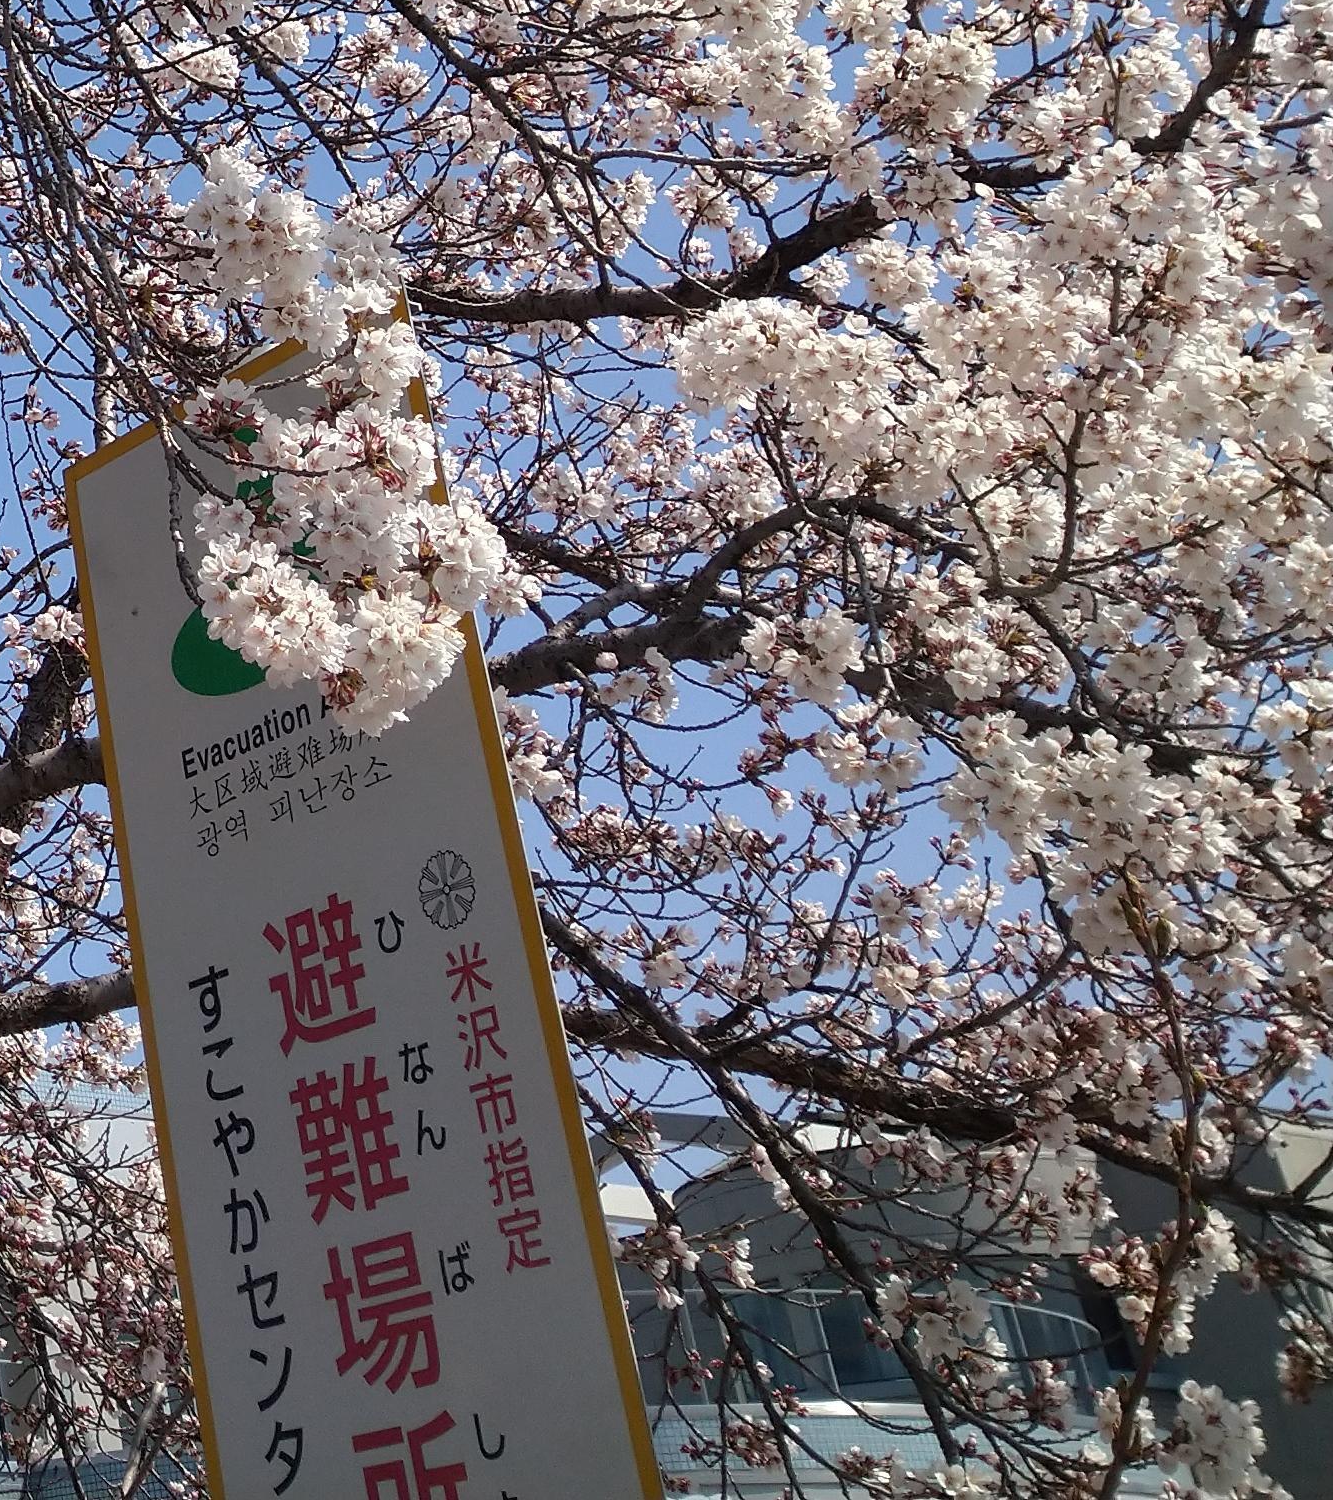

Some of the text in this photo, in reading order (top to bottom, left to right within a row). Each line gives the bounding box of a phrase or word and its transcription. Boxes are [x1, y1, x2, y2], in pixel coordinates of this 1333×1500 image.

[181, 703, 311, 780] Evacuation
[197, 756, 393, 857] 광역 피난장소
[444, 942, 551, 1274] 米沢市指定
[188, 965, 304, 1497] すこやかセンタ
